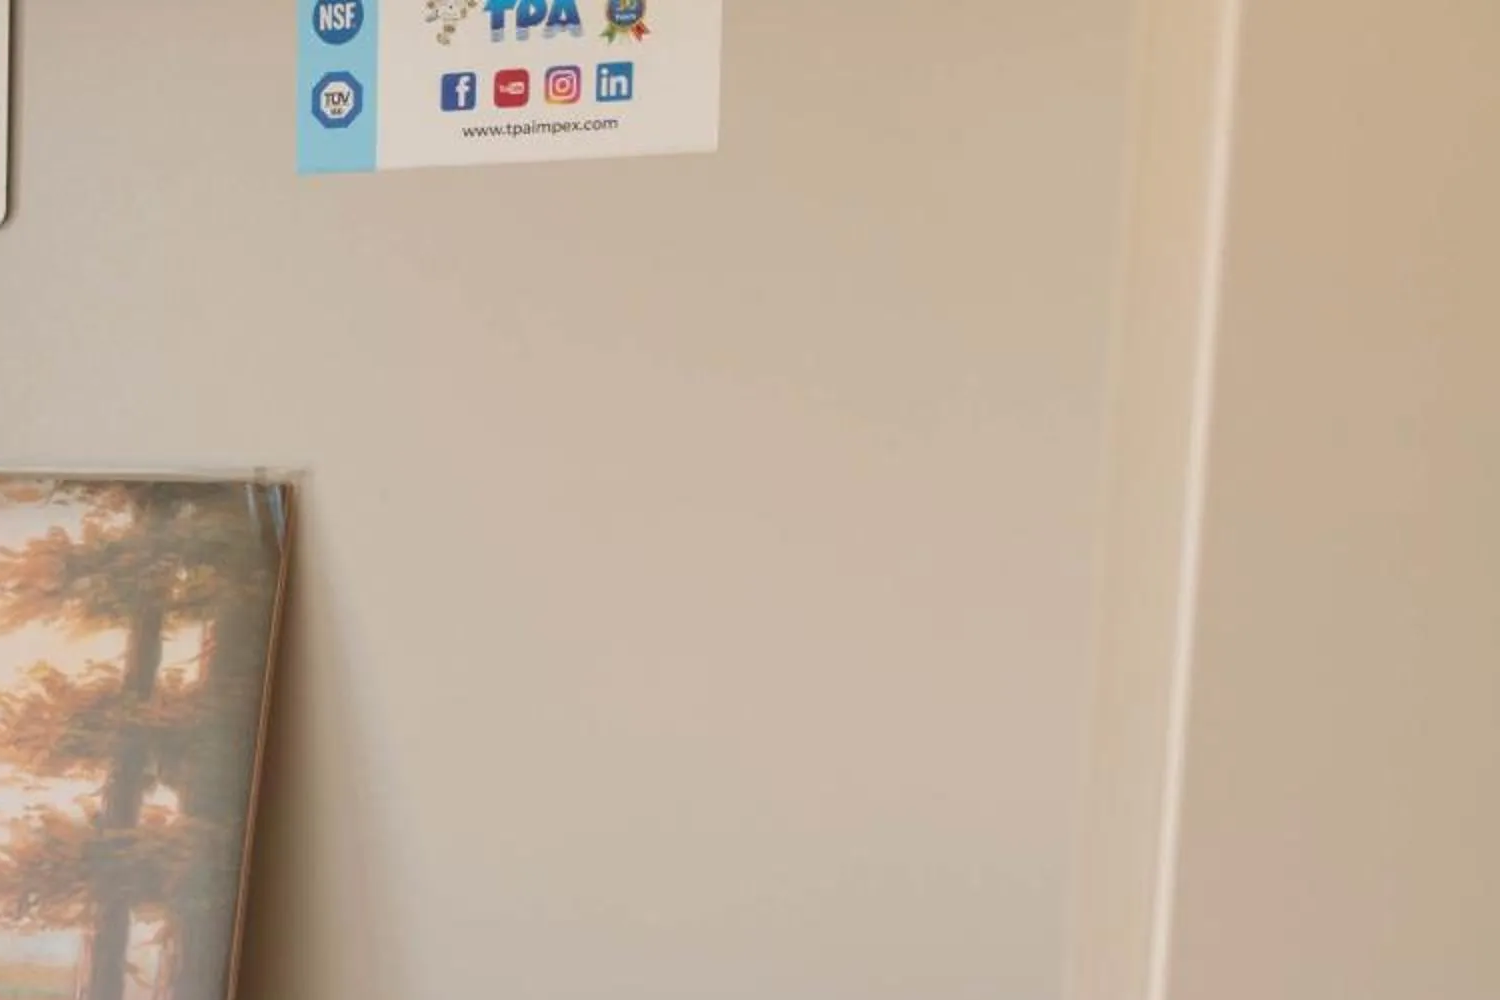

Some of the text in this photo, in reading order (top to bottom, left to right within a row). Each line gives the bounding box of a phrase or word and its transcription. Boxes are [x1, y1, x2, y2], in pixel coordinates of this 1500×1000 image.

[319, 2, 357, 31] NSF
[485, 0, 582, 30] TPA
[460, 116, 620, 139] www.tpaimpex.com
